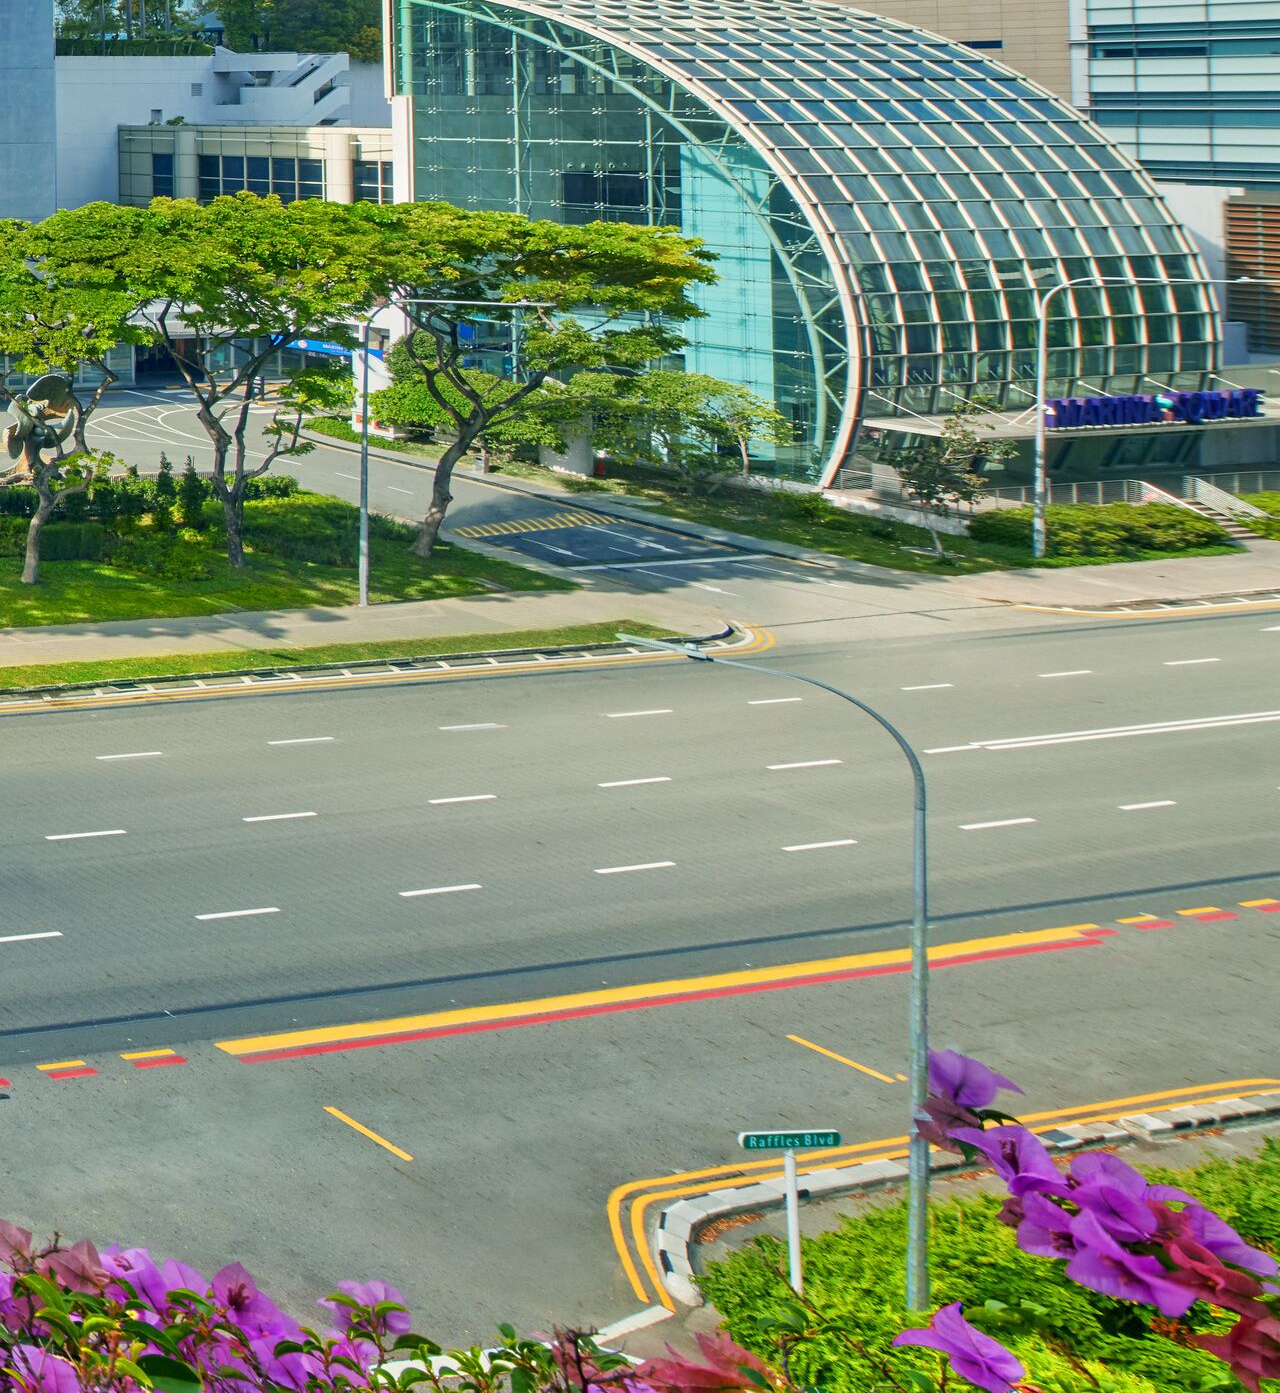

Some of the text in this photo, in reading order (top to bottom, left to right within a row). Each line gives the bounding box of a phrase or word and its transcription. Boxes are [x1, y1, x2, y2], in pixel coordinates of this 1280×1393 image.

[1046, 389, 1266, 429] MARINA SQUARE
[749, 1134, 834, 1148] Raffles Blvd
